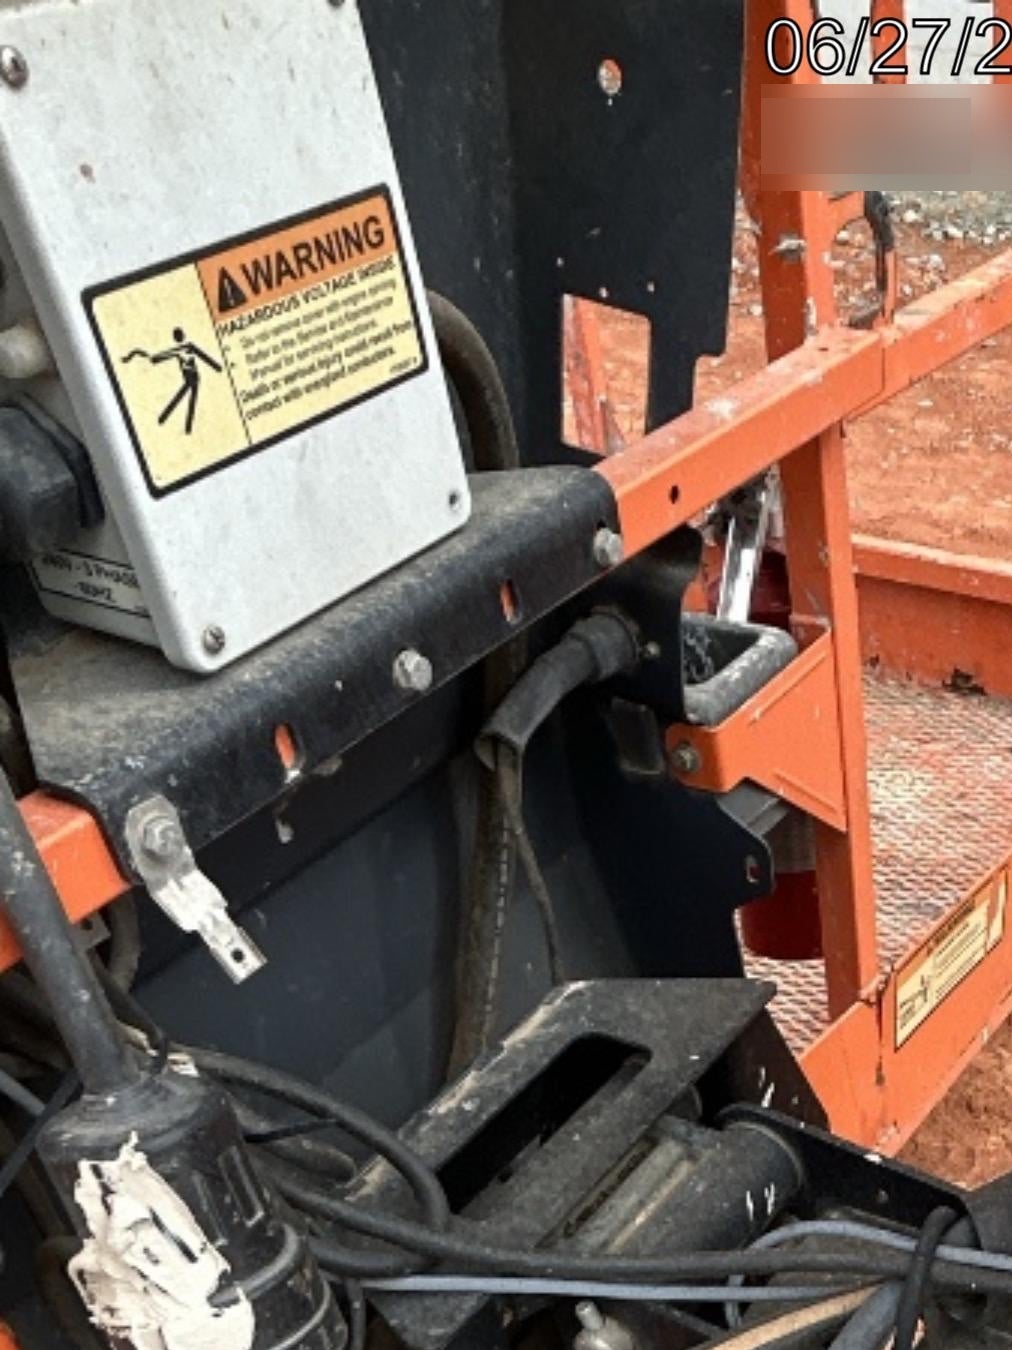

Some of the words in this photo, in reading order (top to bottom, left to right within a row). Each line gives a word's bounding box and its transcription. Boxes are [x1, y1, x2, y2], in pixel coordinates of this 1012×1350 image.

[240, 215, 386, 295] WARNING
[215, 293, 300, 339] HAZARDOUS
[301, 271, 357, 304] VOLTAGE
